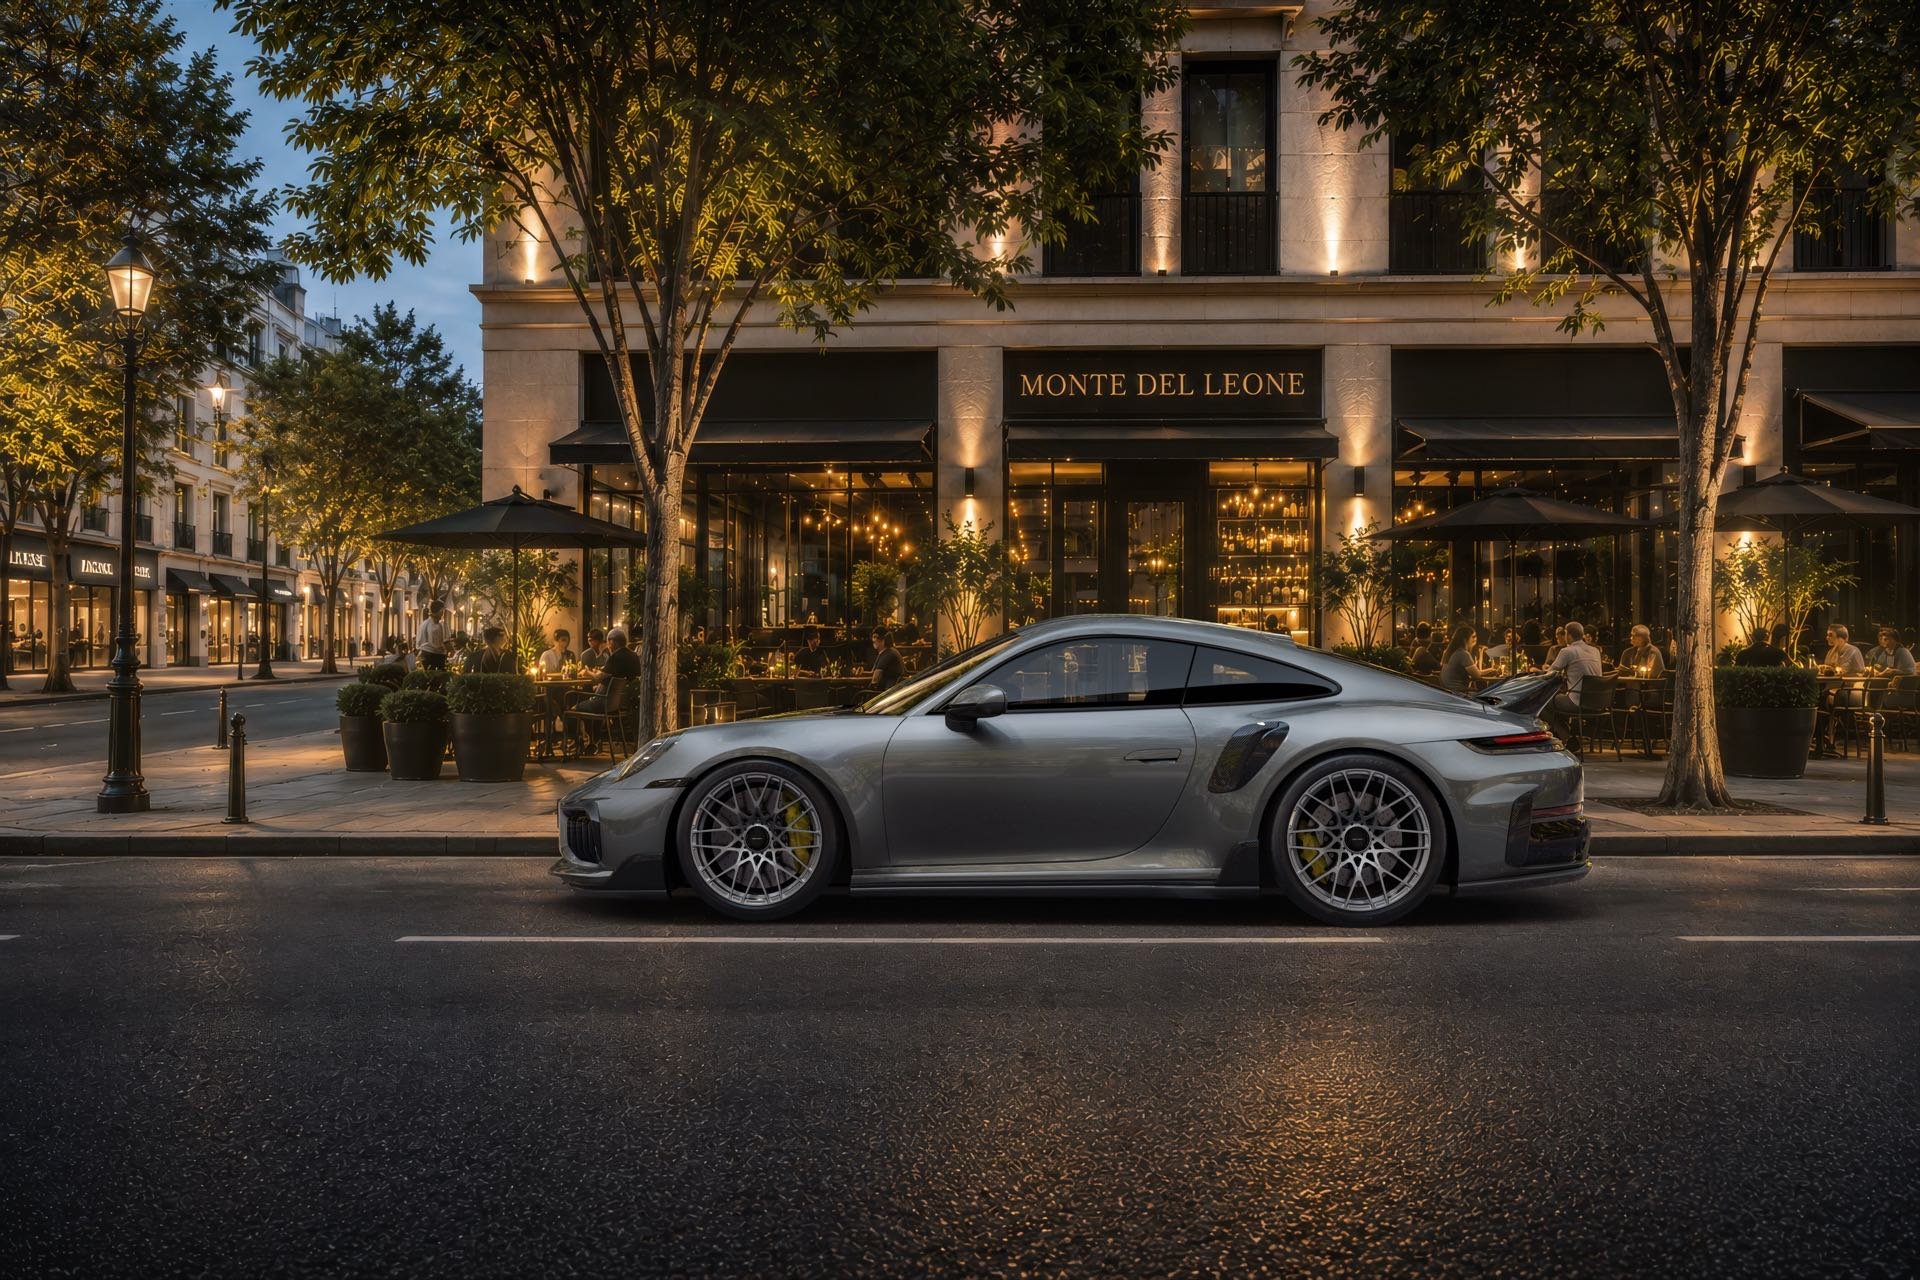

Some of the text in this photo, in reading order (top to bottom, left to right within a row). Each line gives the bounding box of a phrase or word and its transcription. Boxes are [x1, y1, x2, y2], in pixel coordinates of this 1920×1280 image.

[1020, 372, 1305, 396] MONTE DEL LEONE
